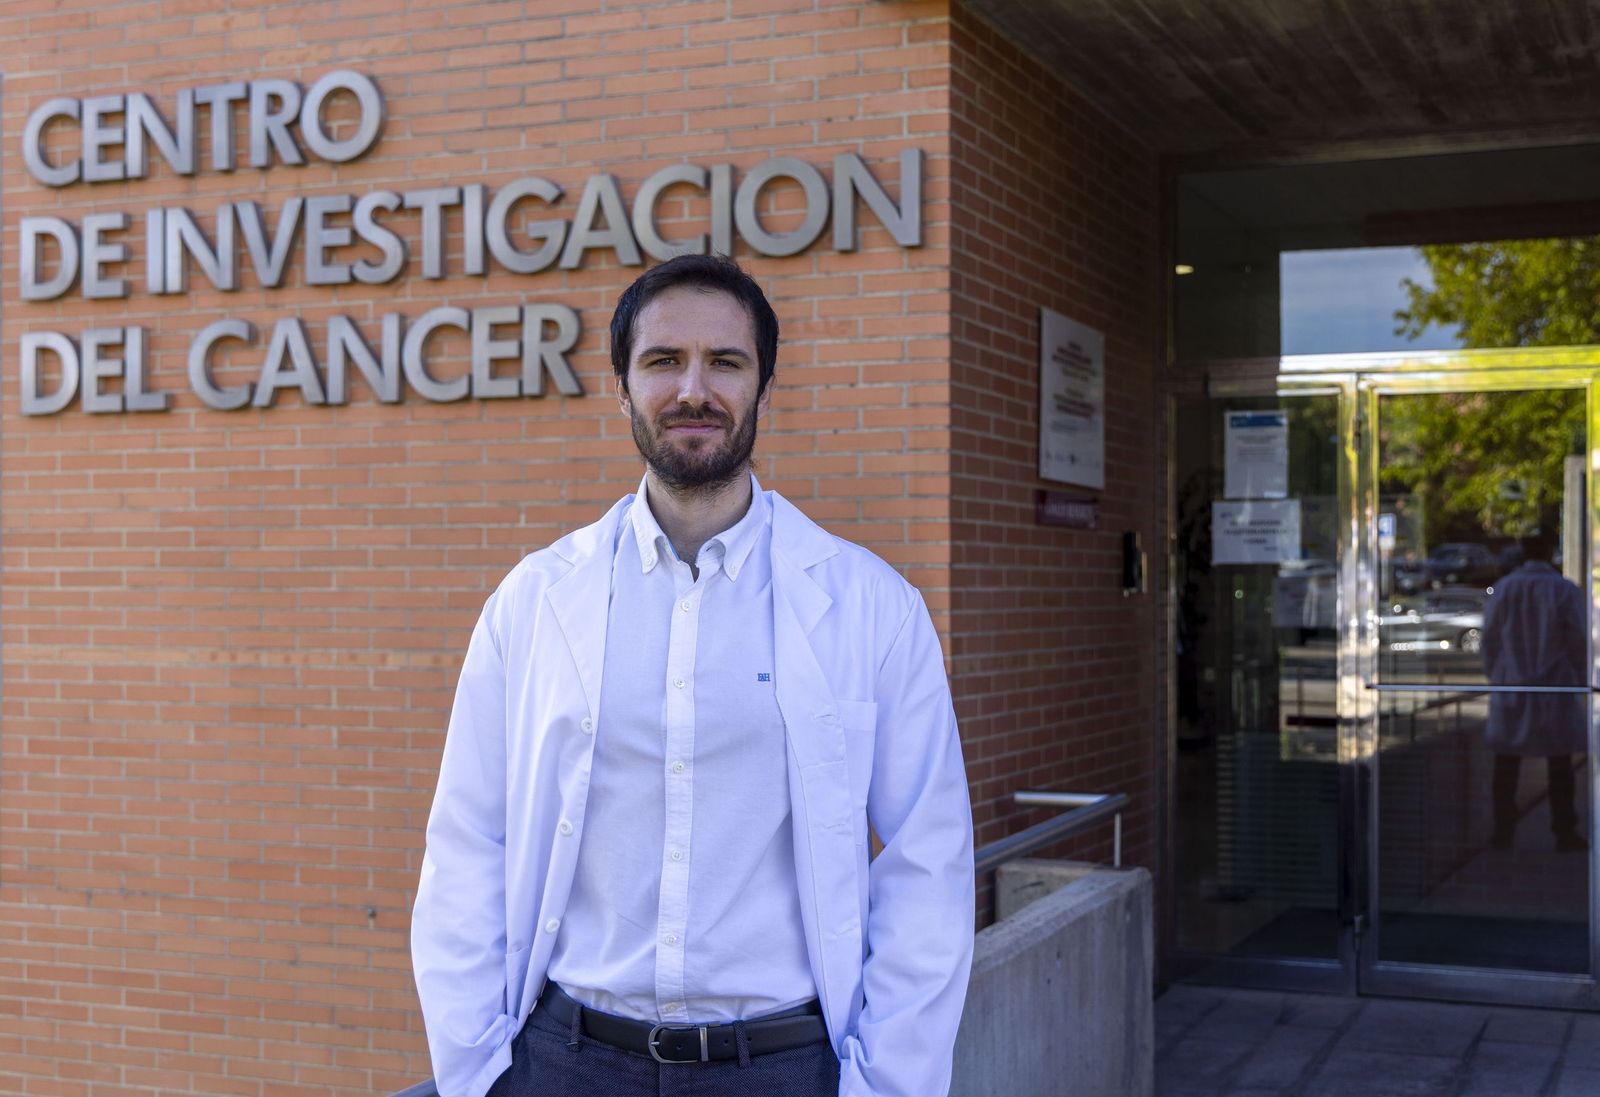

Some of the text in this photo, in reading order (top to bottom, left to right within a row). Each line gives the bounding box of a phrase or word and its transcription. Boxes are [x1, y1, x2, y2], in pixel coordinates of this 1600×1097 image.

[22, 69, 385, 187] CENTRO
[19, 148, 924, 301] DE INVESTIGACION
[19, 303, 583, 416] DEL CANCER
